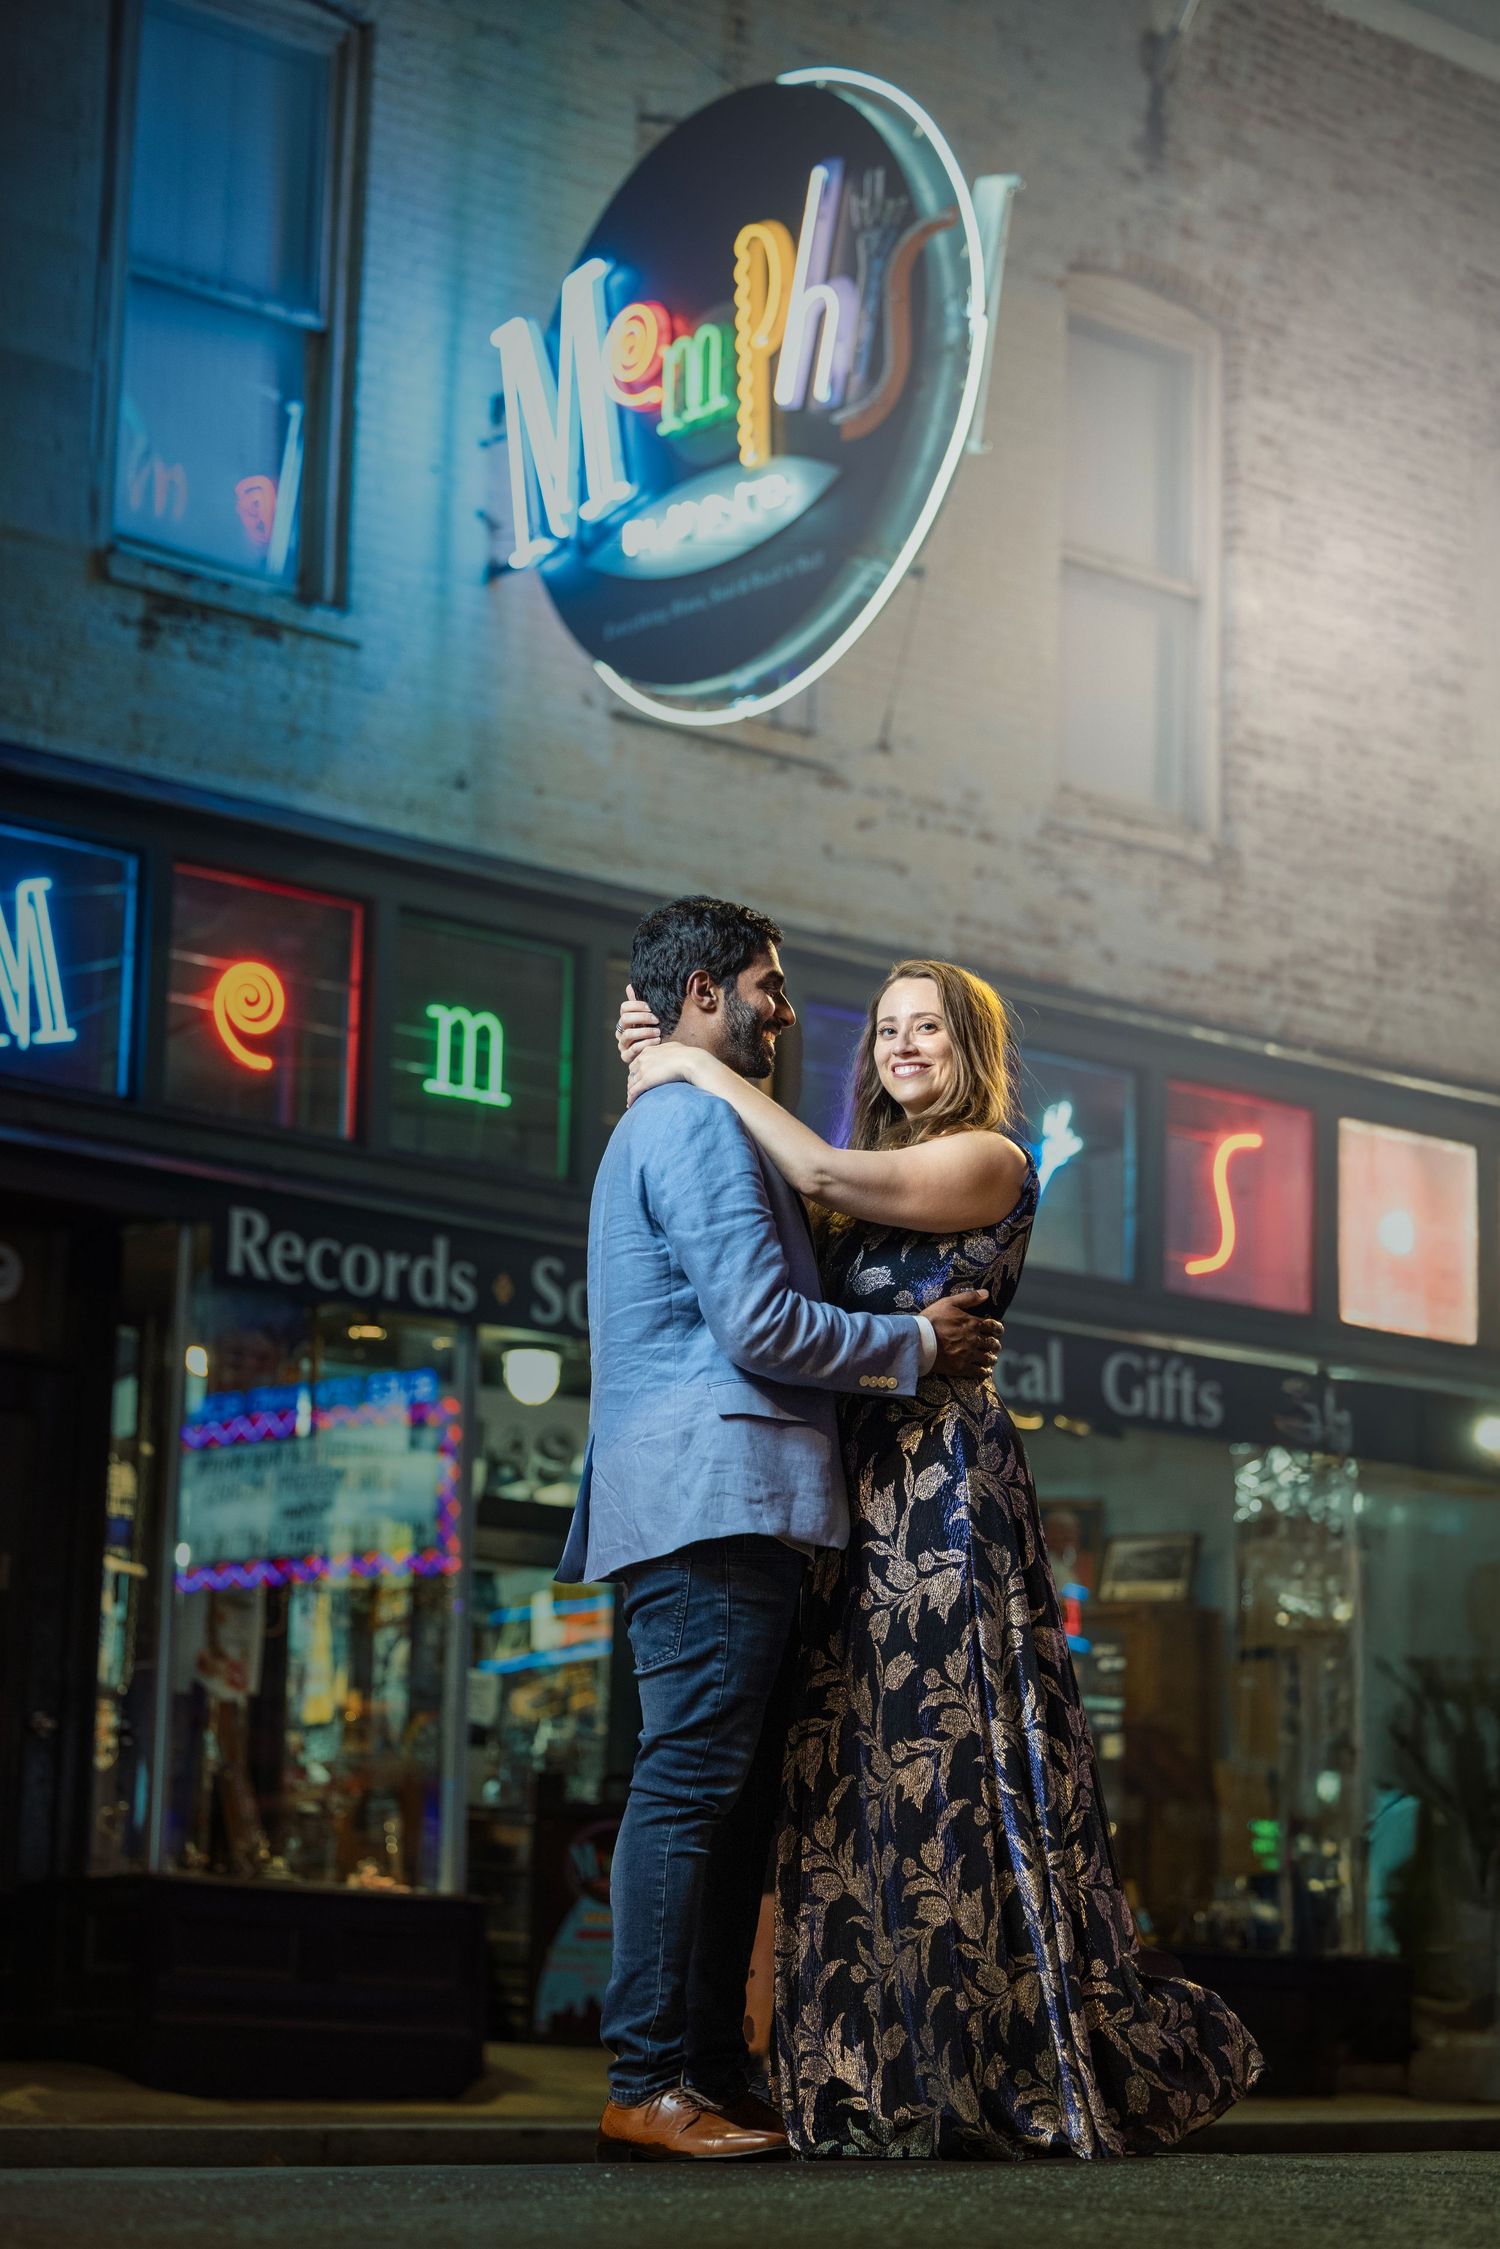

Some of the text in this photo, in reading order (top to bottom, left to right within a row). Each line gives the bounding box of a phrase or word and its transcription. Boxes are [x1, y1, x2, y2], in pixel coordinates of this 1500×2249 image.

[226, 1206, 479, 1312] Records
[993, 1337, 1063, 1403] cal
[1102, 1350, 1225, 1429] Gifts
